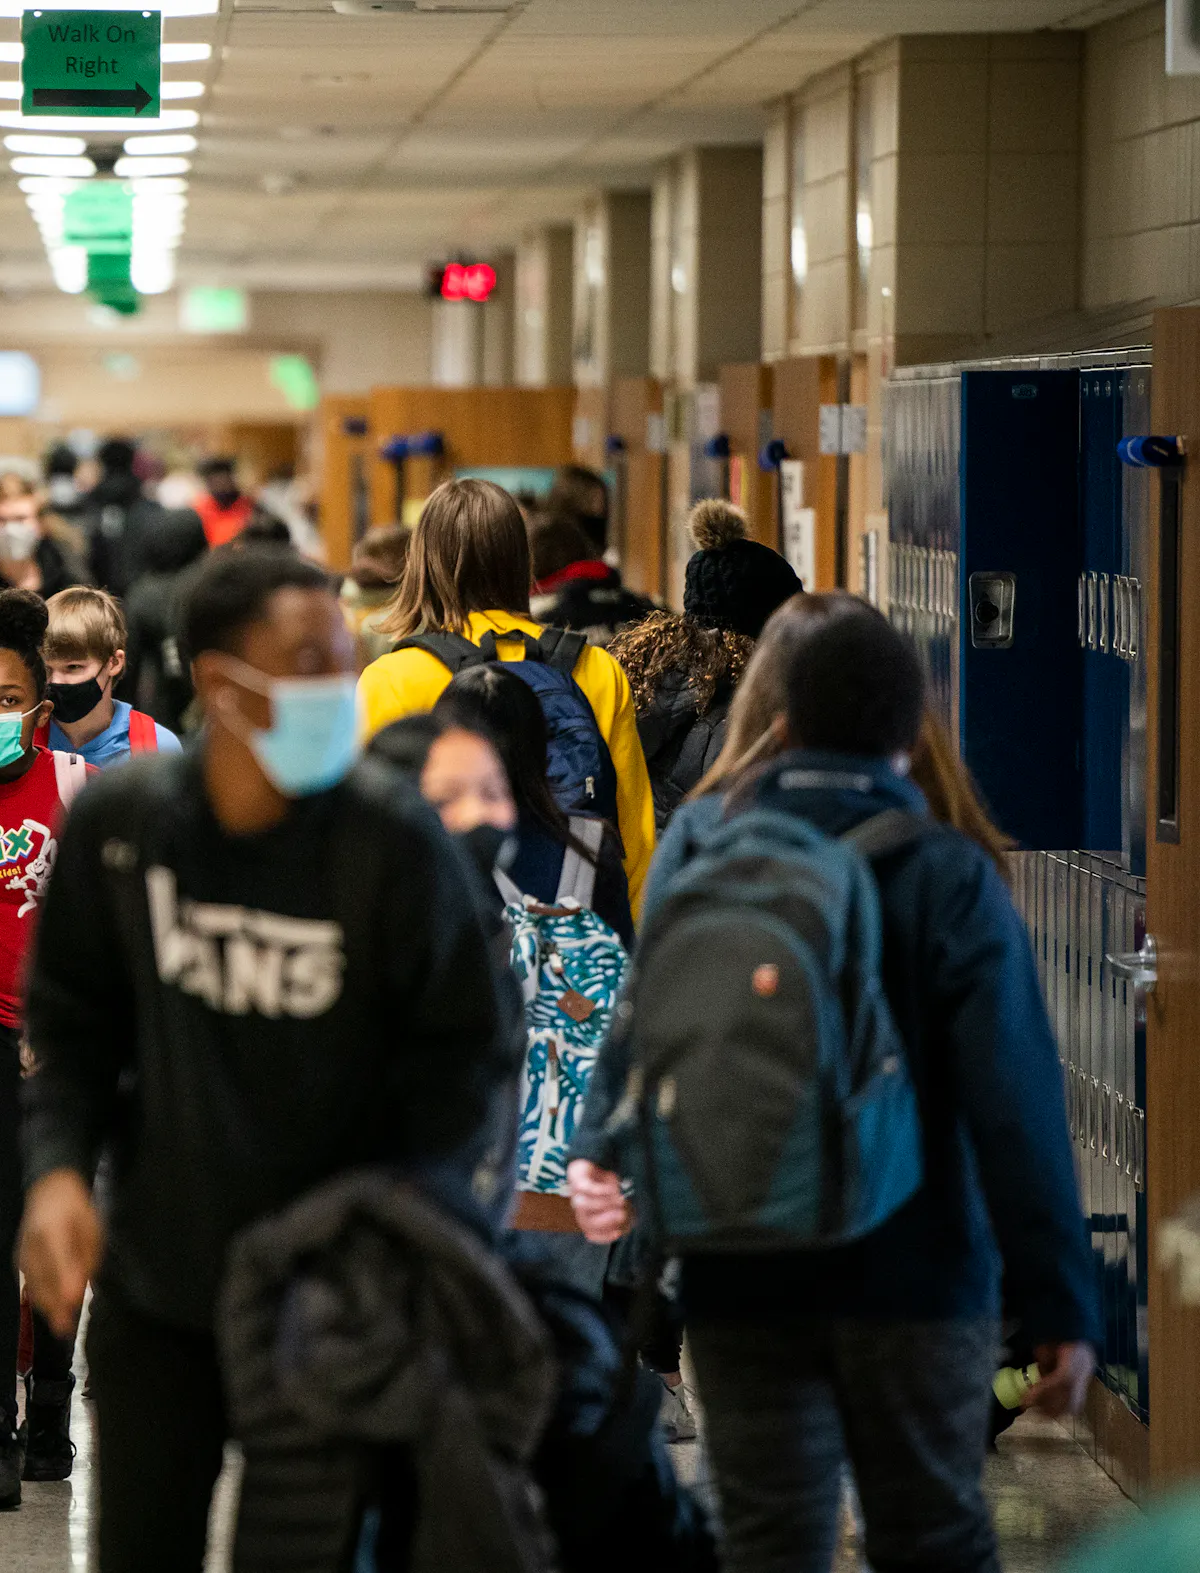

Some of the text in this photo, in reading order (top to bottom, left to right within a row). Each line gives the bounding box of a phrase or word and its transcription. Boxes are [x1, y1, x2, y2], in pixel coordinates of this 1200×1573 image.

[48, 24, 135, 43] Walk On
[65, 56, 119, 78] Right
[145, 865, 347, 1020] VANS
